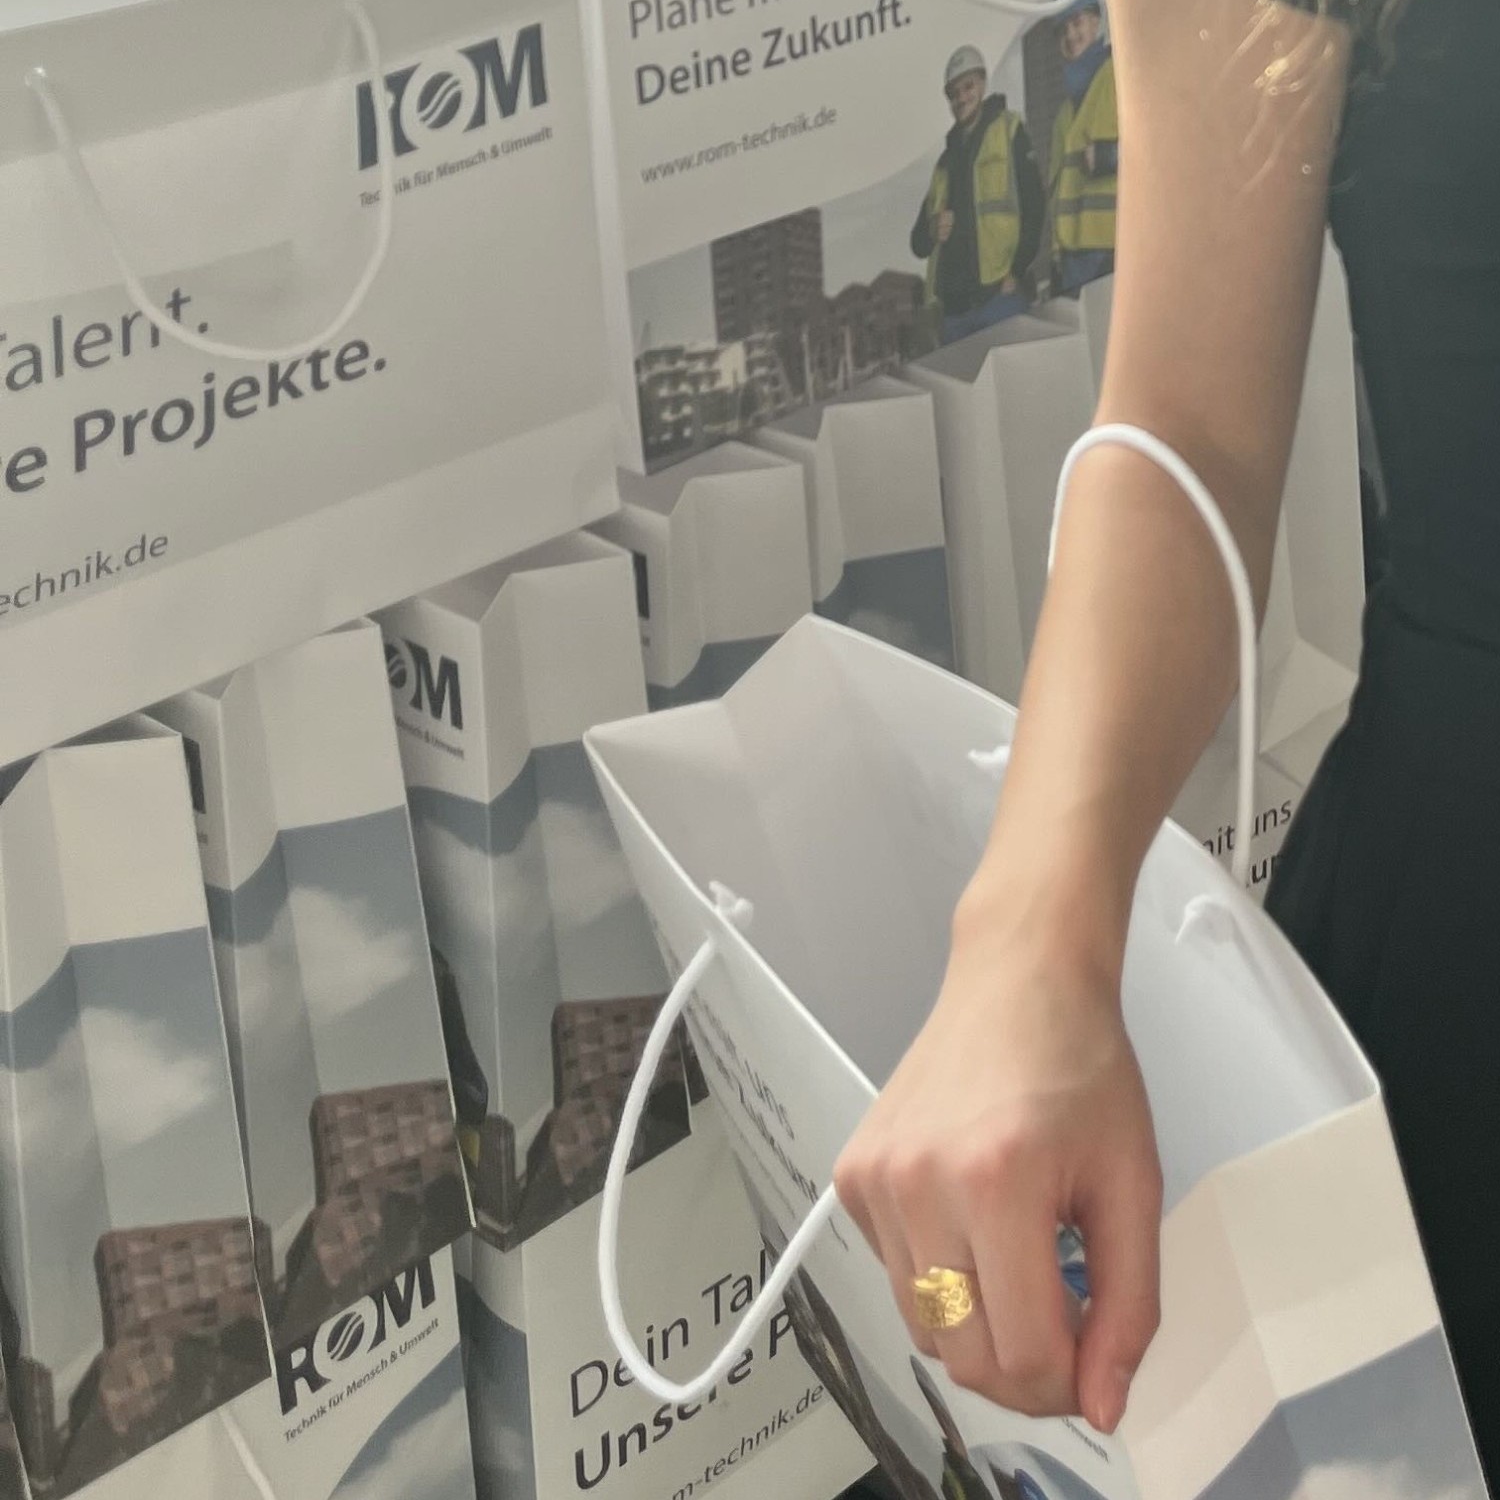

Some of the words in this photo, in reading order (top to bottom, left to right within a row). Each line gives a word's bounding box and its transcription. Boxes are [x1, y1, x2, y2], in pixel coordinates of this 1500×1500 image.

[634, 47, 752, 106] Deine
[0, 286, 209, 392] alent.
[73, 338, 387, 475] Projekte.
[0, 533, 169, 616] echnik.de
[384, 637, 464, 731] OM
[275, 1256, 437, 1417] ROM
[284, 1405, 327, 1442] Technik
[328, 1391, 344, 1409] für
[346, 1358, 388, 1396] Mensch
[390, 1350, 398, 1365] &
[399, 1317, 440, 1356] Umwelt
[570, 1317, 690, 1419] Dein
[671, 1385, 825, 1500] m-technik.de
